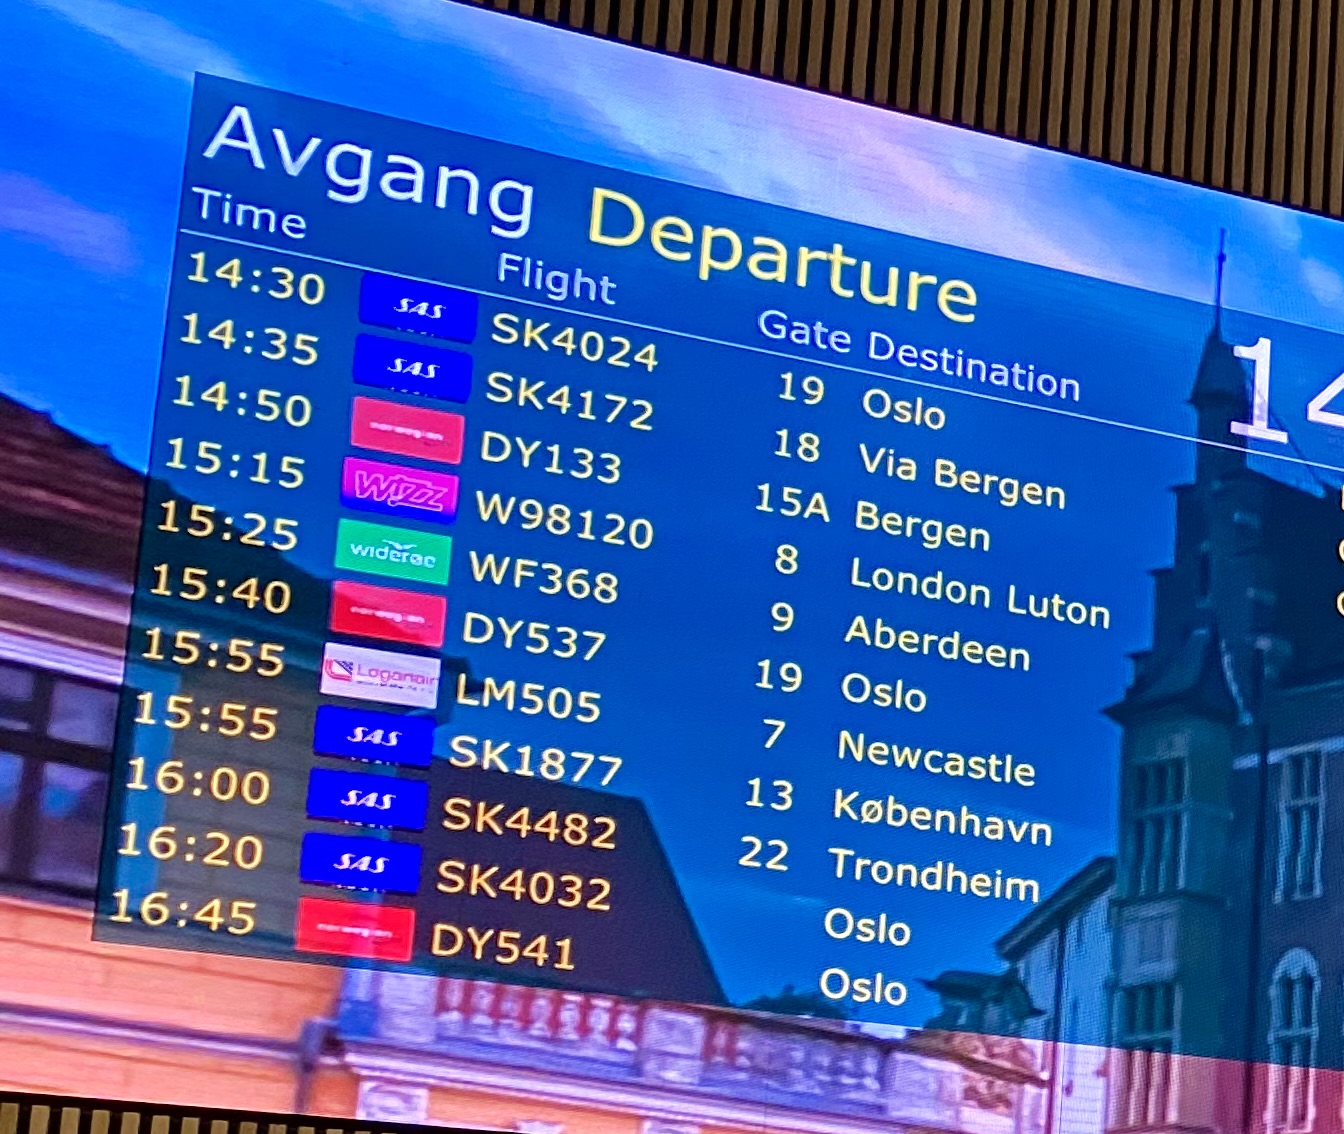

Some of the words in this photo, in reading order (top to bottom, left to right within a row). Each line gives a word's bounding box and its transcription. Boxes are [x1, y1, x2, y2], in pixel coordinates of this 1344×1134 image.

[191, 186, 307, 239] Time
[497, 252, 616, 306] Flight
[758, 309, 851, 353] Gate
[868, 331, 1080, 402] Destination
[203, 105, 534, 239] Avgang
[588, 187, 977, 323] Departure
[180, 313, 319, 366] 14:35
[387, 358, 440, 379] SAS
[485, 373, 654, 431] SK4172
[774, 429, 820, 462] 18
[859, 443, 916, 481] Via
[935, 459, 1066, 511] Bergen
[187, 251, 325, 305] 14:30
[393, 298, 447, 319] SAS
[491, 312, 658, 372] SK4024
[779, 372, 825, 405] 19
[862, 388, 946, 430] Oslo
[166, 437, 305, 489] 15:15
[476, 490, 654, 550] W98120
[775, 544, 798, 575] 8
[851, 557, 990, 609] London
[1008, 585, 1110, 629] Luton
[172, 374, 312, 427] 14:50
[481, 433, 622, 484] DY133
[755, 483, 830, 523] 15A
[855, 502, 990, 552] Bergen
[149, 563, 291, 614] 15:40
[463, 612, 607, 662] DY537
[755, 658, 802, 693] 19
[841, 672, 927, 713] Oslo
[157, 500, 299, 551] 15:25
[470, 550, 619, 604] WF368
[771, 602, 794, 632] 9
[845, 615, 1031, 671] Aberdeen
[134, 691, 278, 741] 15:55
[346, 726, 403, 746] SAS
[449, 735, 623, 787] SK1877
[745, 777, 793, 812] 13
[833, 788, 1053, 847] København
[142, 627, 285, 677] 15:55
[456, 673, 602, 724] LM505
[762, 719, 786, 749] 7
[838, 730, 1036, 787] Newcastle
[118, 821, 263, 870] 16:20
[333, 852, 390, 874] SAS
[436, 860, 611, 911] SK4032
[825, 908, 911, 947] Oslo
[126, 756, 270, 805] 16:00
[340, 789, 396, 811] SAS
[443, 797, 616, 850] SK4482
[738, 836, 789, 872] 22
[828, 847, 1040, 904] Trondheim
[110, 888, 256, 936] 16:45
[431, 924, 575, 971] DY541
[819, 967, 907, 1006] Oslo
